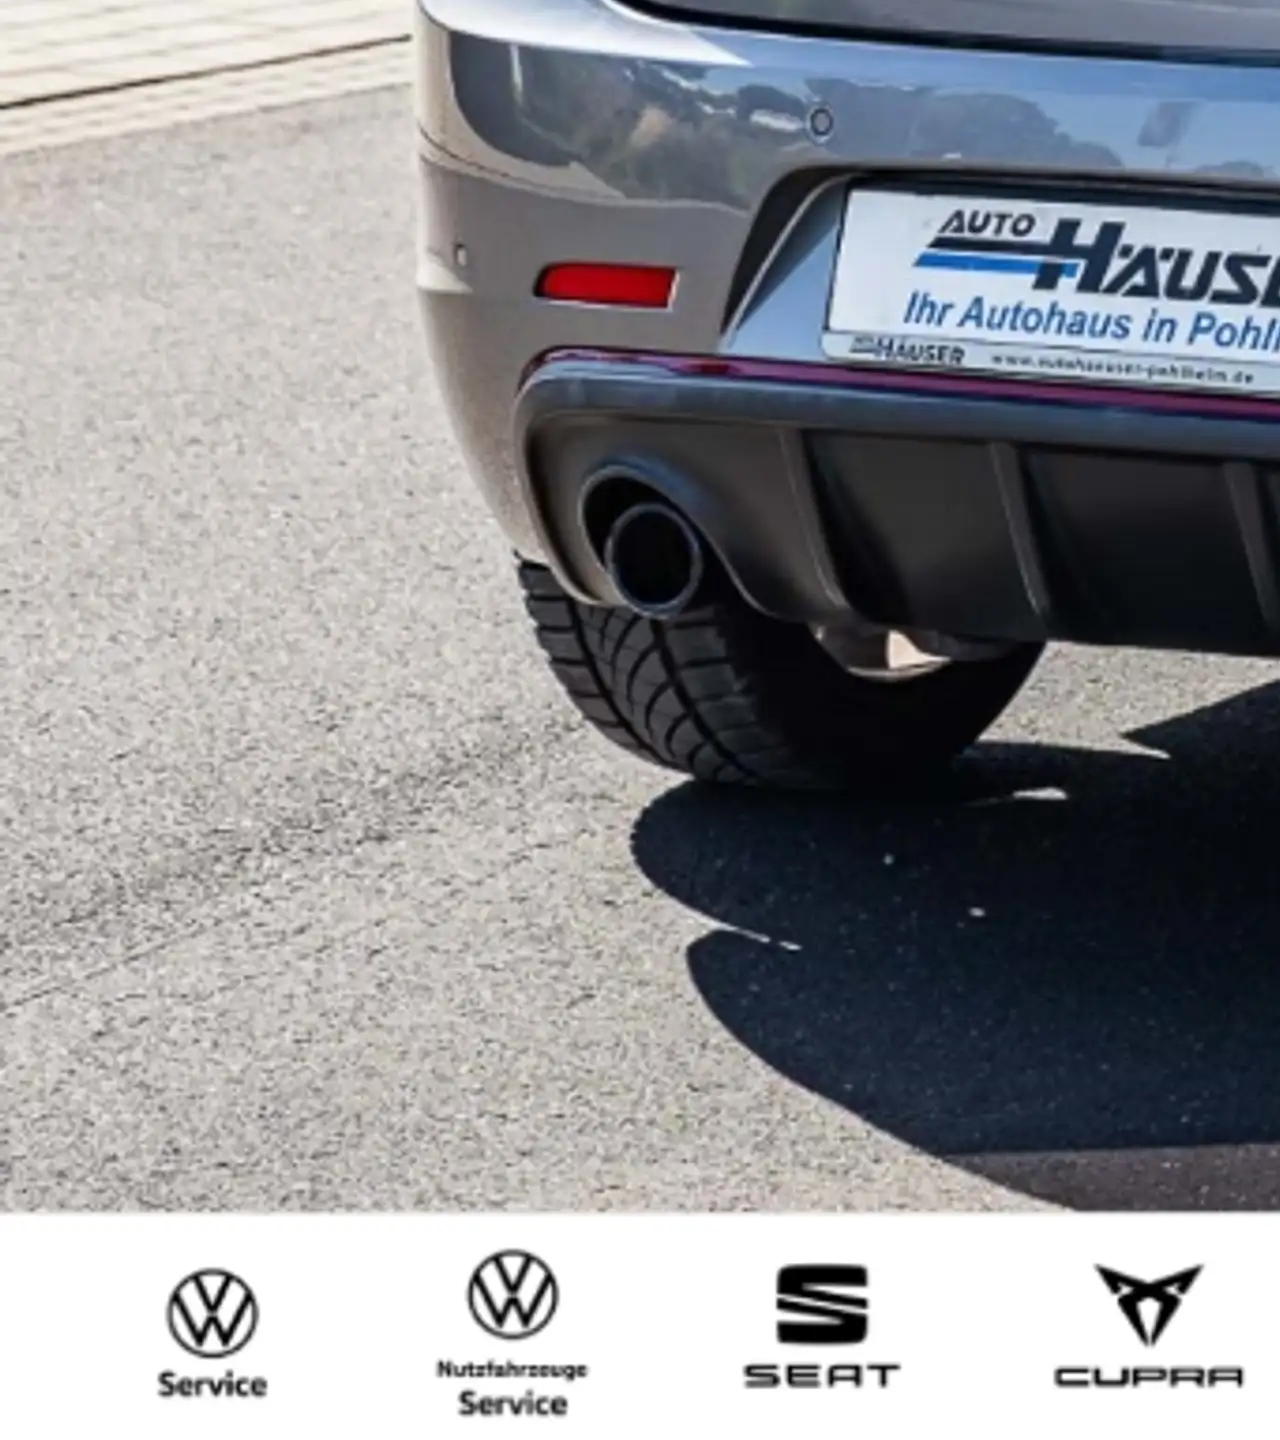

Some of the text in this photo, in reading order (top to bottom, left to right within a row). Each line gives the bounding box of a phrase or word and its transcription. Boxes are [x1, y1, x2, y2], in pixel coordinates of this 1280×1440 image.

[939, 209, 1036, 238] AUTO
[902, 289, 956, 328] Ihr
[957, 296, 1133, 342] Autohaus
[1142, 307, 1179, 345] in
